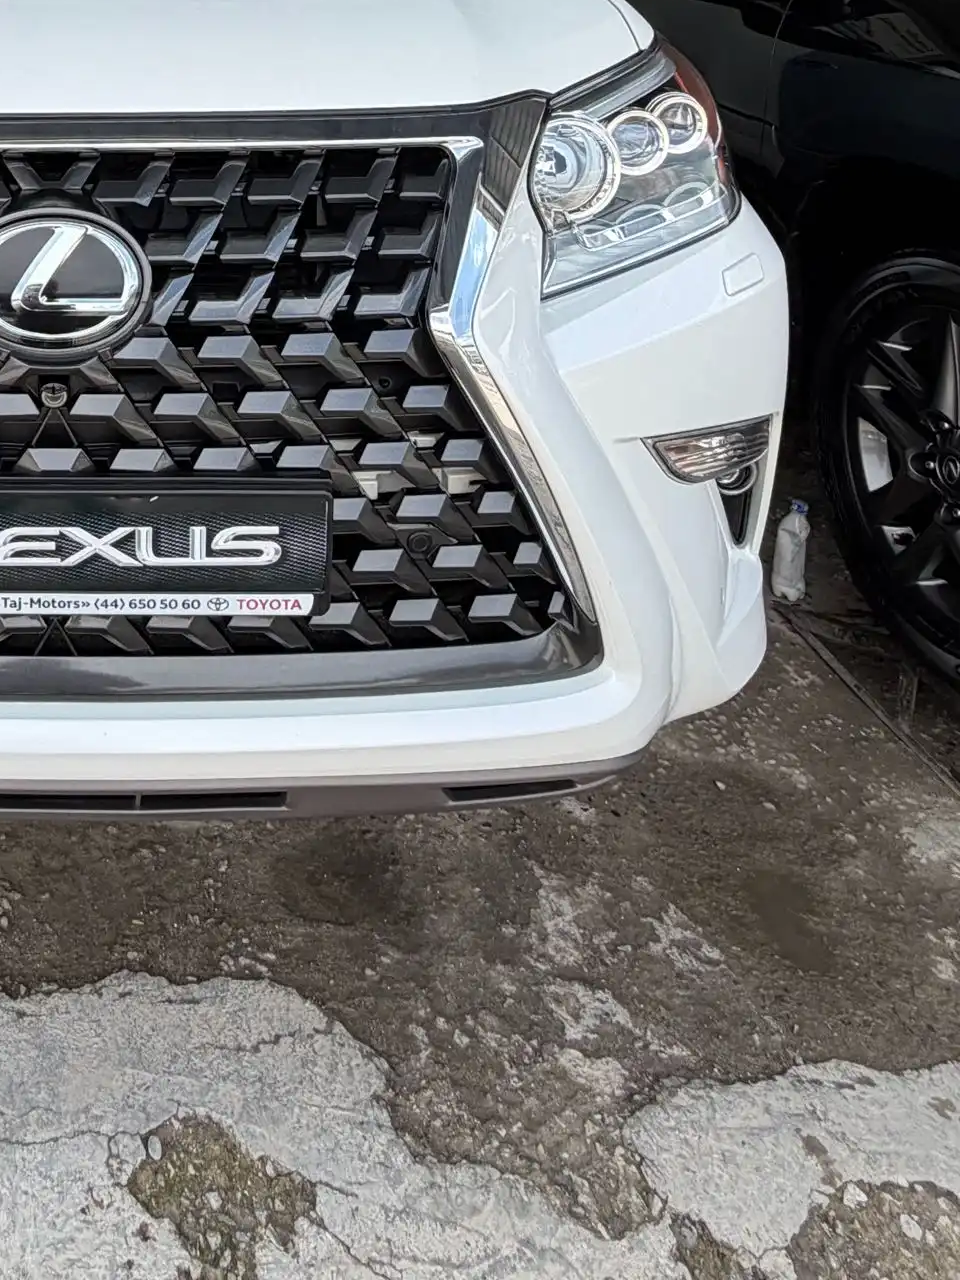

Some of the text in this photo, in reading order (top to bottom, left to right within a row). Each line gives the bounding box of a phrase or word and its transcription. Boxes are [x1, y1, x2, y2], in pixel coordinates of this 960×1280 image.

[128, 598, 157, 610] 650
[159, 598, 179, 610] 50
[181, 598, 202, 610] 60
[236, 598, 303, 611] TOYOTA
